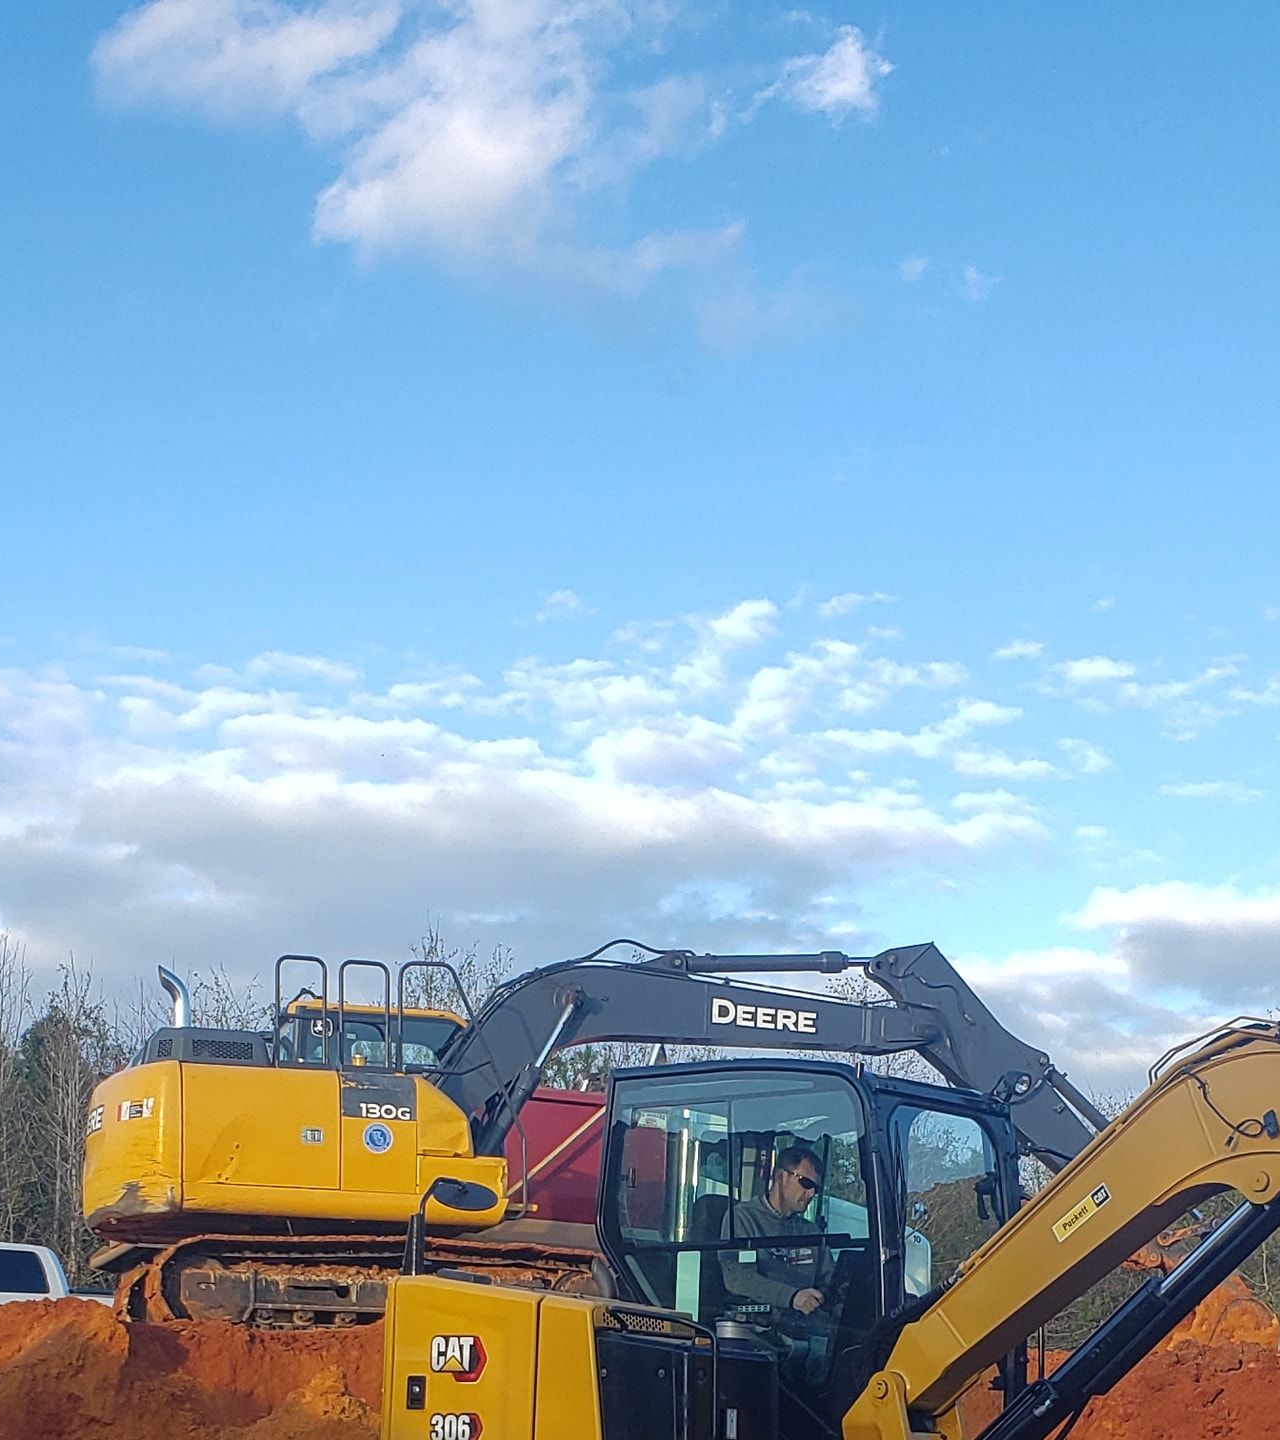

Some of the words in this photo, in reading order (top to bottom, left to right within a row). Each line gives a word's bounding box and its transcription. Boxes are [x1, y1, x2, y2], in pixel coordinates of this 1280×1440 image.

[711, 997, 817, 1034] DEERE
[359, 1103, 412, 1120] 130G
[1062, 1205, 1089, 1231] Puckett
[1093, 1188, 1107, 1204] CAT
[431, 1336, 475, 1372] CAT
